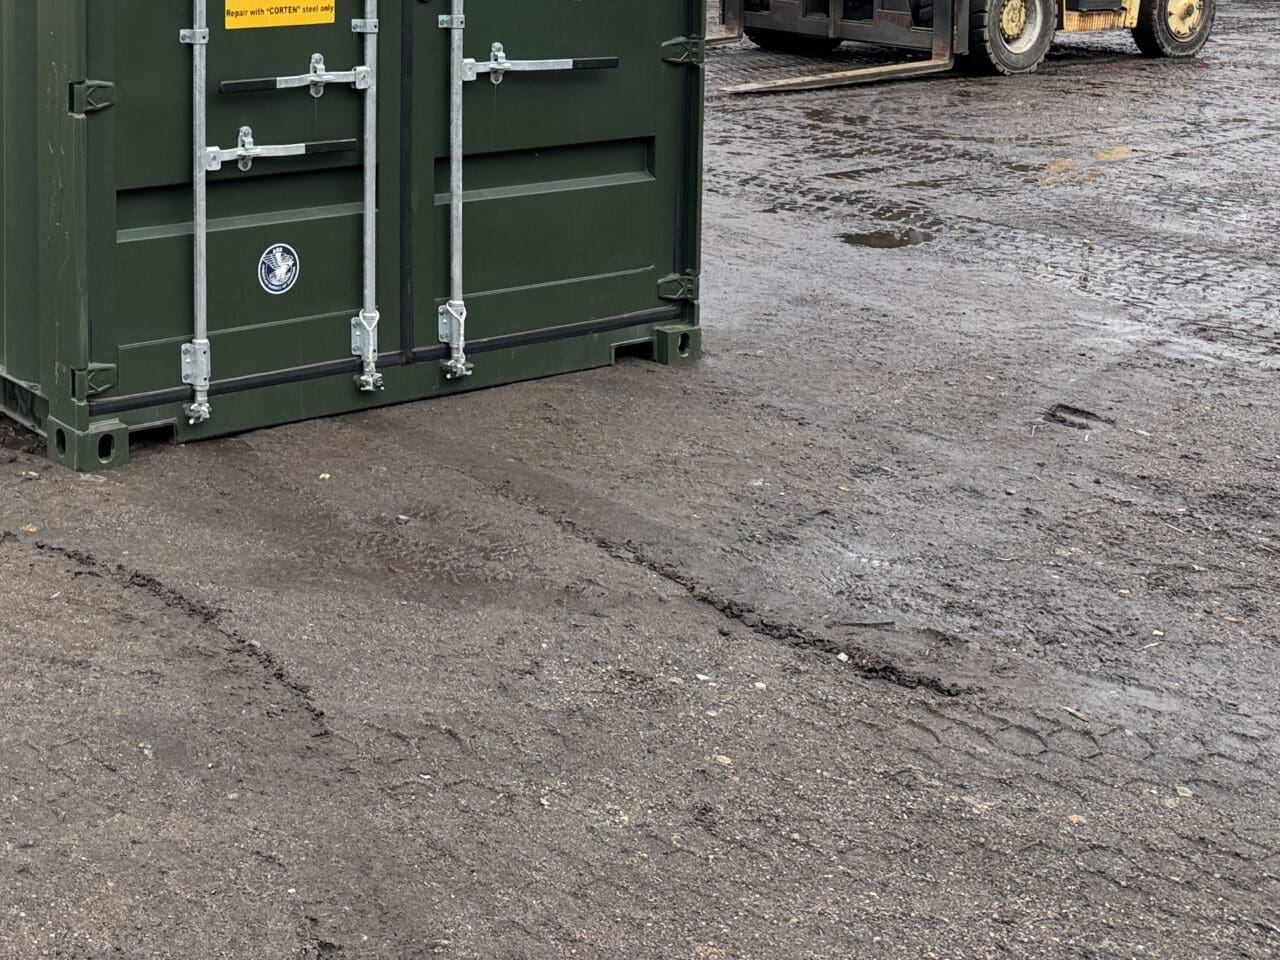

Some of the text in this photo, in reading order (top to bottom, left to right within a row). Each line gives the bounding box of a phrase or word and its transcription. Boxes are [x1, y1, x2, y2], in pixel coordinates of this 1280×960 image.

[226, 4, 334, 18] Repair with "CORTEN" steel only
